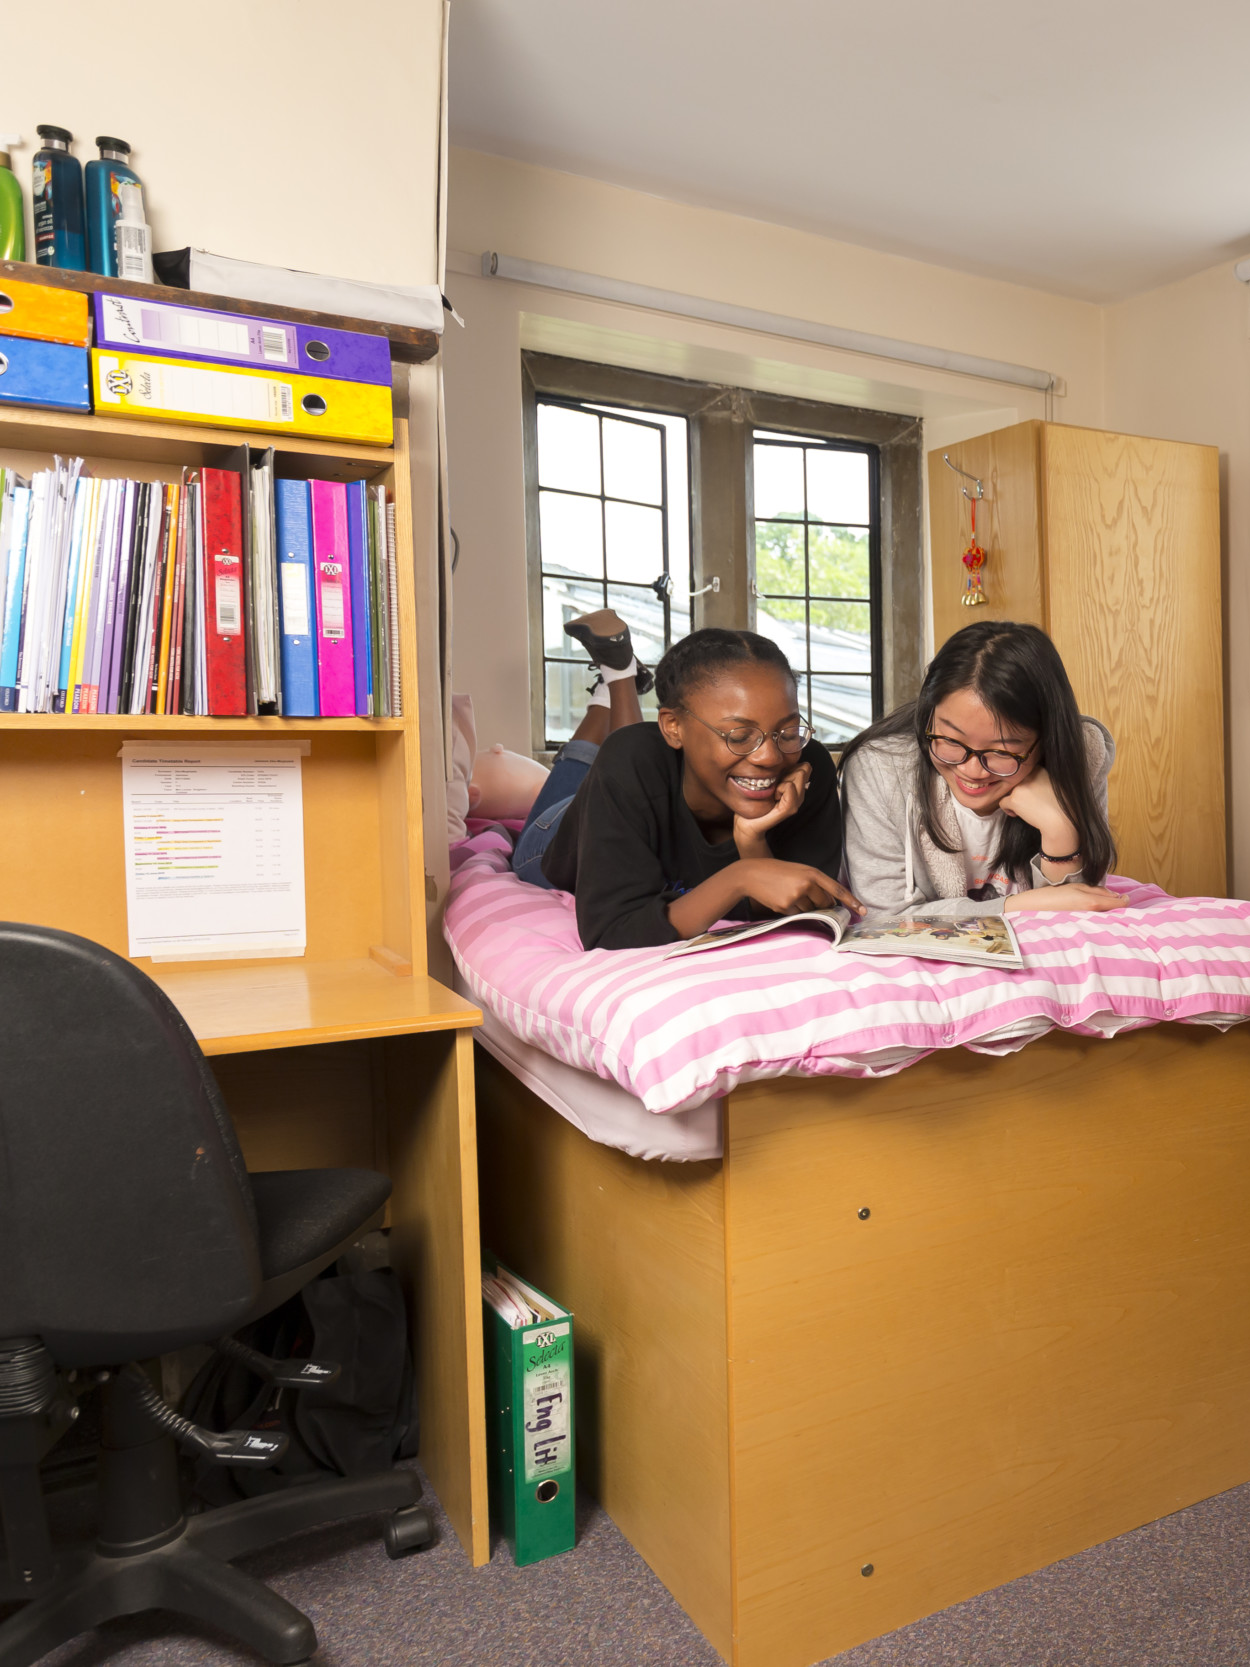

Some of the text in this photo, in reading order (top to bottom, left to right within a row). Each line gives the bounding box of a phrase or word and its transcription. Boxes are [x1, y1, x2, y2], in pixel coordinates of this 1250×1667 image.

[107, 370, 132, 395] IXL
[536, 1332, 556, 1348] IXL
[526, 1340, 566, 1373] Selecta
[525, 1392, 563, 1433] Eng
[534, 1434, 566, 1465] Lit
